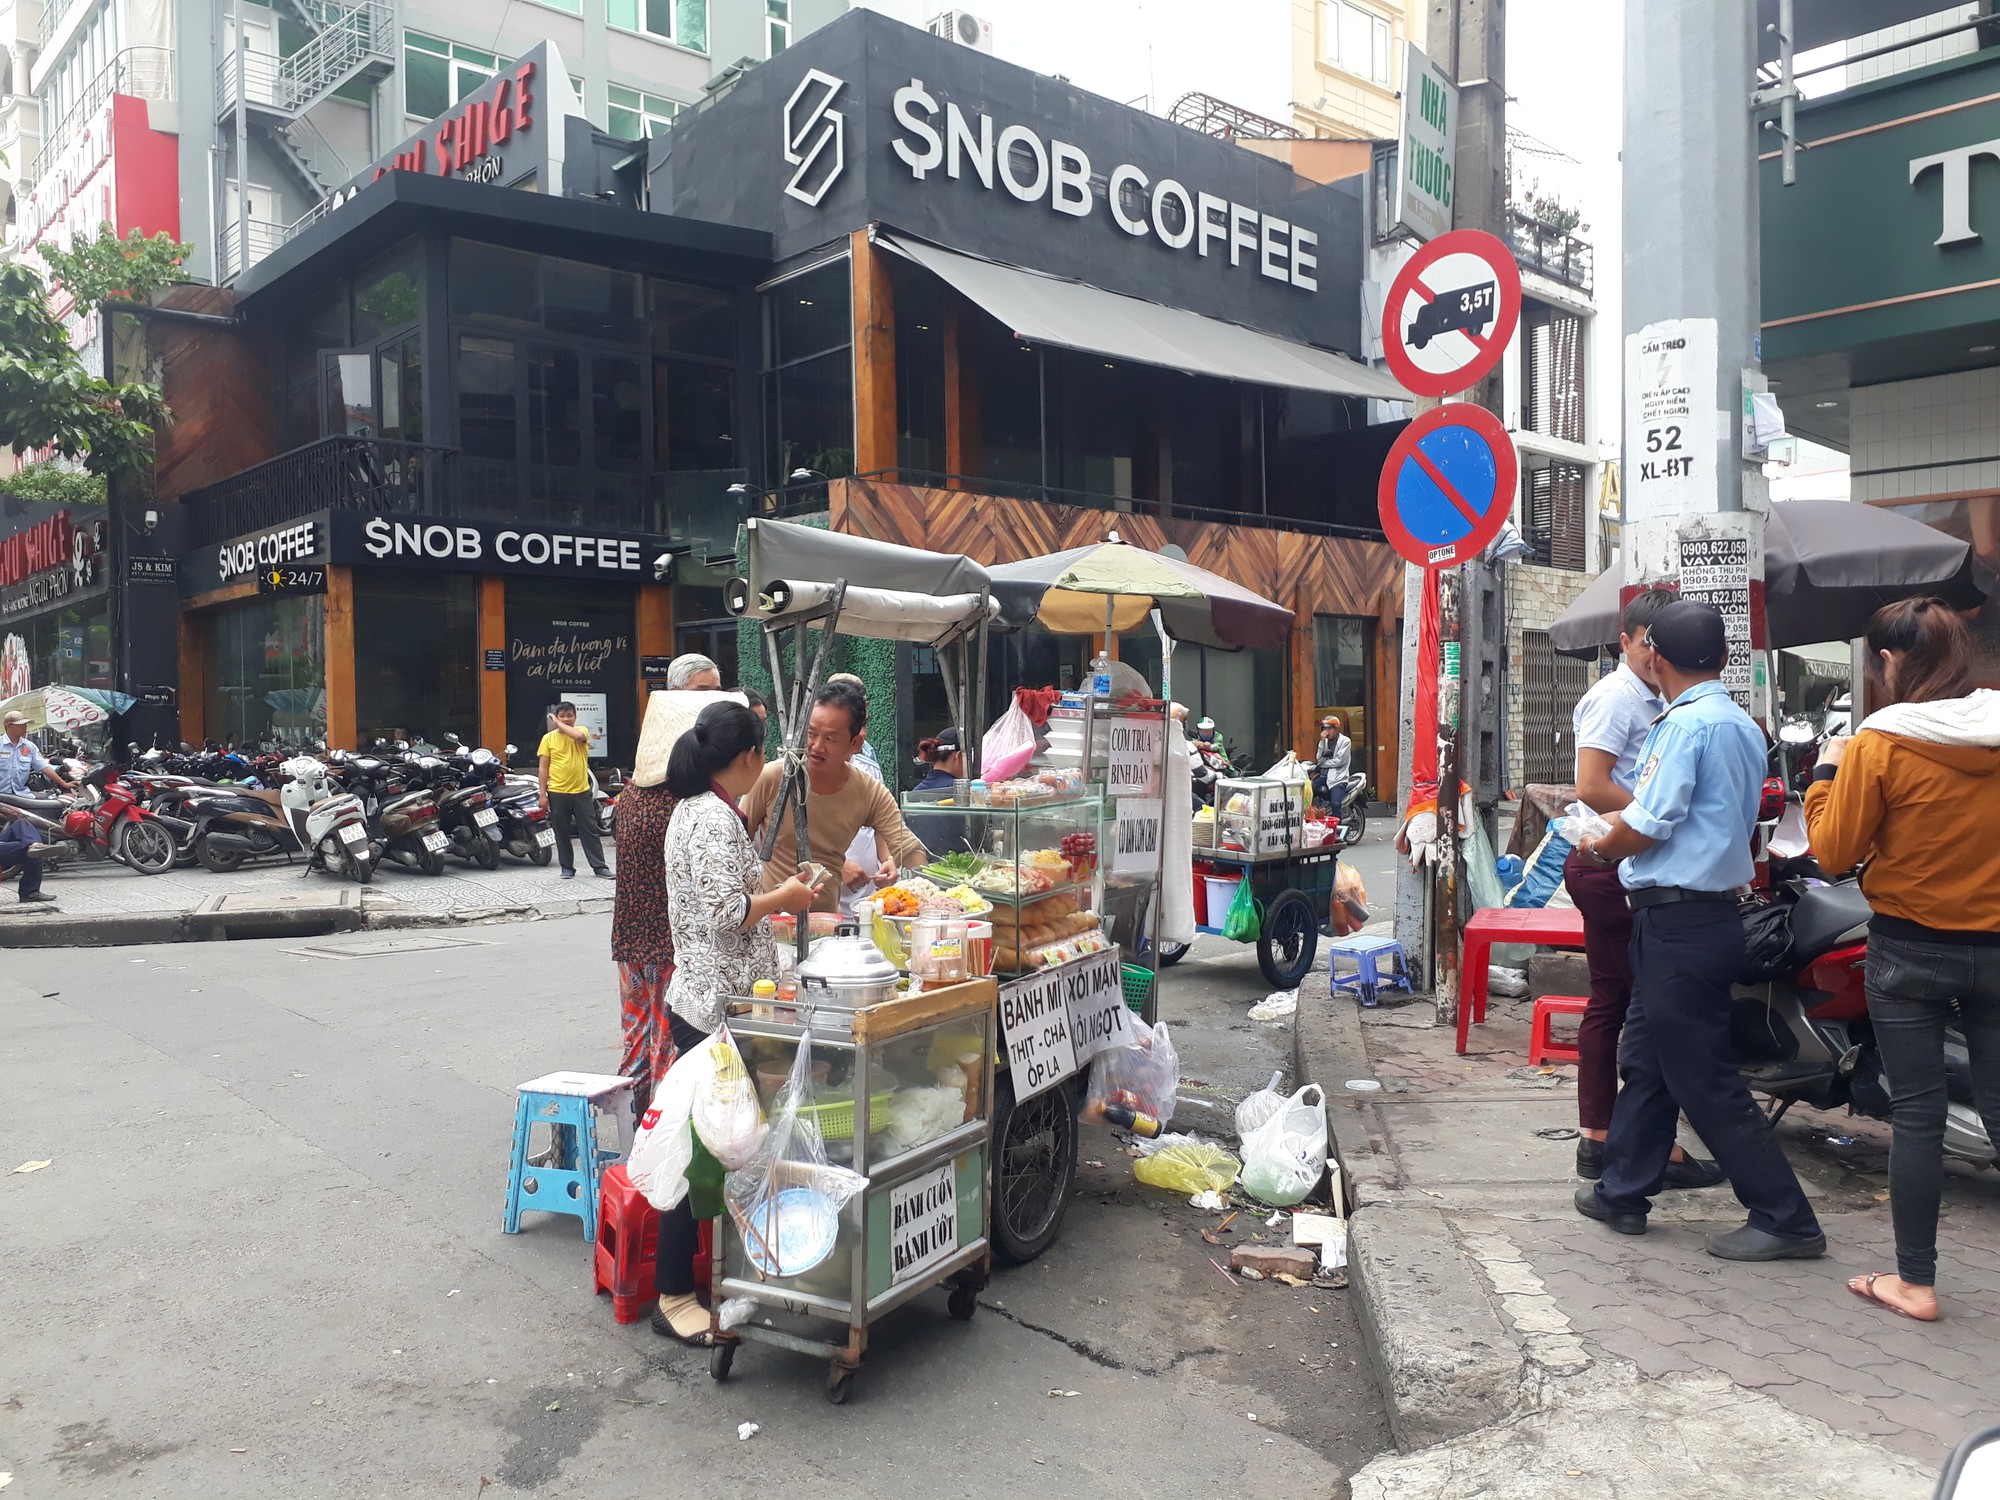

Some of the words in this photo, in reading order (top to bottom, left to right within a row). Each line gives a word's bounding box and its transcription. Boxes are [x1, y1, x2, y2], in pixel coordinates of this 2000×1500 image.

[1420, 72, 1447, 136] NHÀ
[1108, 163, 1318, 292] COFFEE
[1459, 287, 1492, 313] 3,5T
[1646, 426, 1682, 452] 52
[1641, 457, 1693, 482] XL-BT
[258, 521, 314, 564] COFFEE
[495, 530, 641, 570] COFFEE
[1429, 546, 1454, 560] OPTONE
[1682, 541, 1747, 556] 0909.622.058
[131, 562, 143, 571] JS
[145, 562, 152, 571] &
[154, 563, 172, 572] KIM
[1683, 556, 1714, 566] VAY
[288, 571, 323, 586] 24/7
[1682, 575, 1747, 585] 0909.622.058
[1112, 727, 1131, 752] CƠM
[1111, 758, 1131, 785] BÌNH
[1133, 758, 1149, 785] DÂN
[1067, 967, 1089, 1002] XÔI
[1004, 987, 1044, 1031] BÁNH
[1046, 973, 1062, 1013] MÌ
[1089, 1004, 1122, 1041] NGỌT
[1010, 1036, 1035, 1065] THỊT
[1044, 1017, 1067, 1048] CHẢ
[1046, 1055, 1061, 1079] LA
[894, 1192, 924, 1230] BÁNH
[894, 1232, 929, 1272] BÁNH
